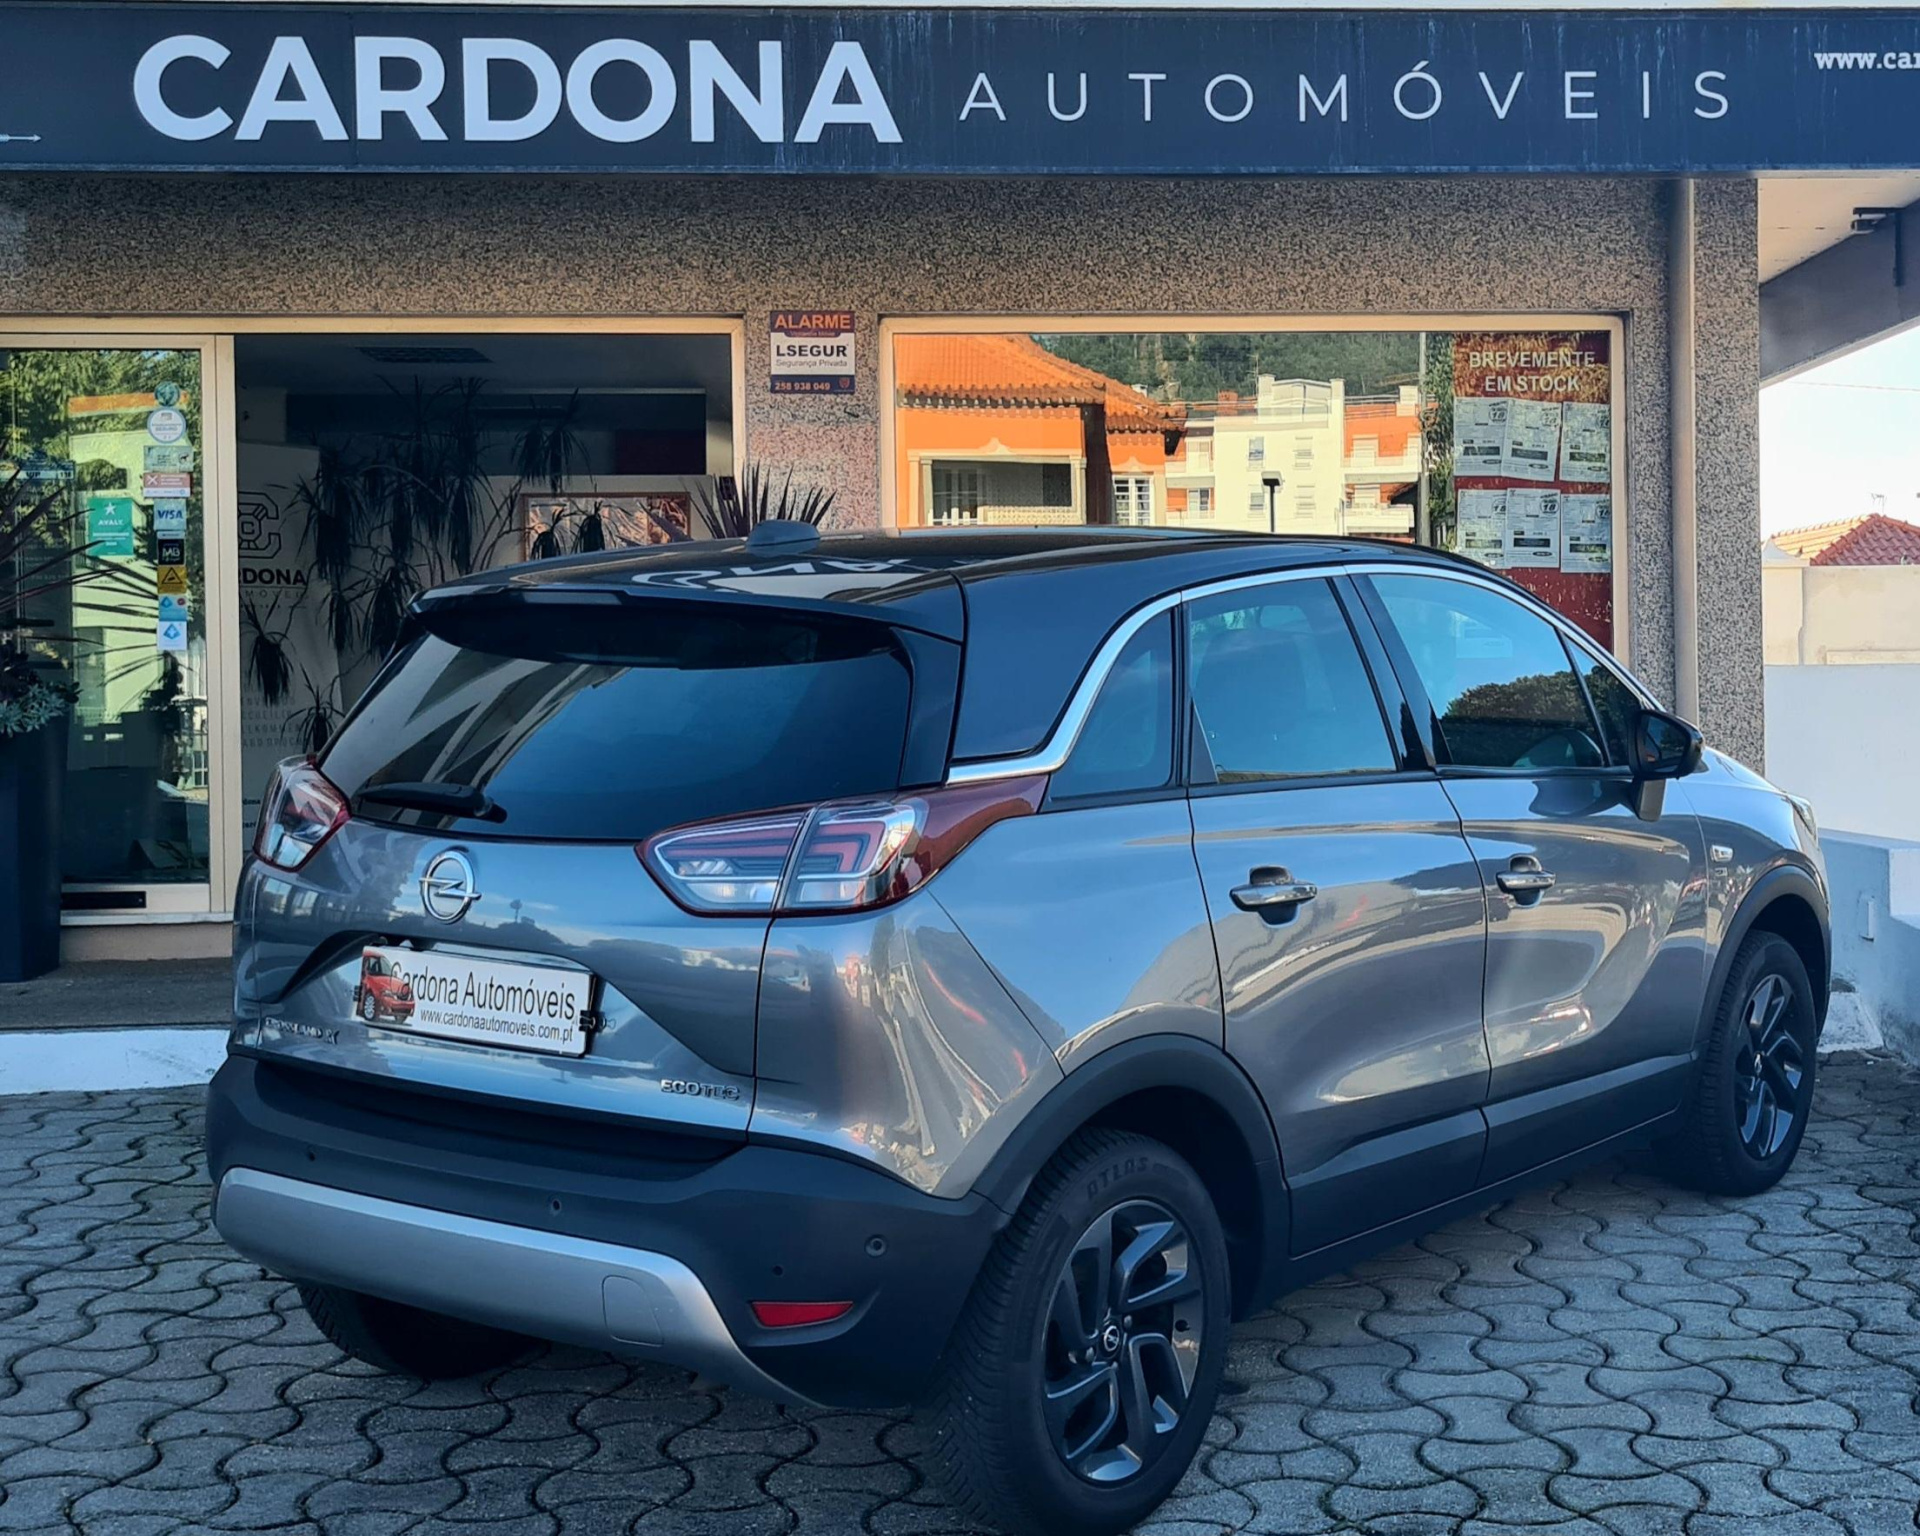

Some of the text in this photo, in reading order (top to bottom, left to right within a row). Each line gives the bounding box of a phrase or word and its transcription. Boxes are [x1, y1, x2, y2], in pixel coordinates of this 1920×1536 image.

[133, 34, 1729, 145] CARDONA AUTOMÓVEIS
[774, 314, 851, 329] ALARME
[776, 345, 848, 357] LSEGUR
[1469, 351, 1596, 369] BREVEMENTE
[775, 359, 848, 369] Segurança Privada
[1485, 375, 1580, 392] EM STOCK
[157, 510, 183, 519] VISA
[240, 568, 307, 586] DONA
[390, 961, 576, 1021] Cardona Automóveis
[420, 1008, 574, 1045] www.cardonaautomoveis.com.pt
[660, 1079, 740, 1101] ECOTEC
